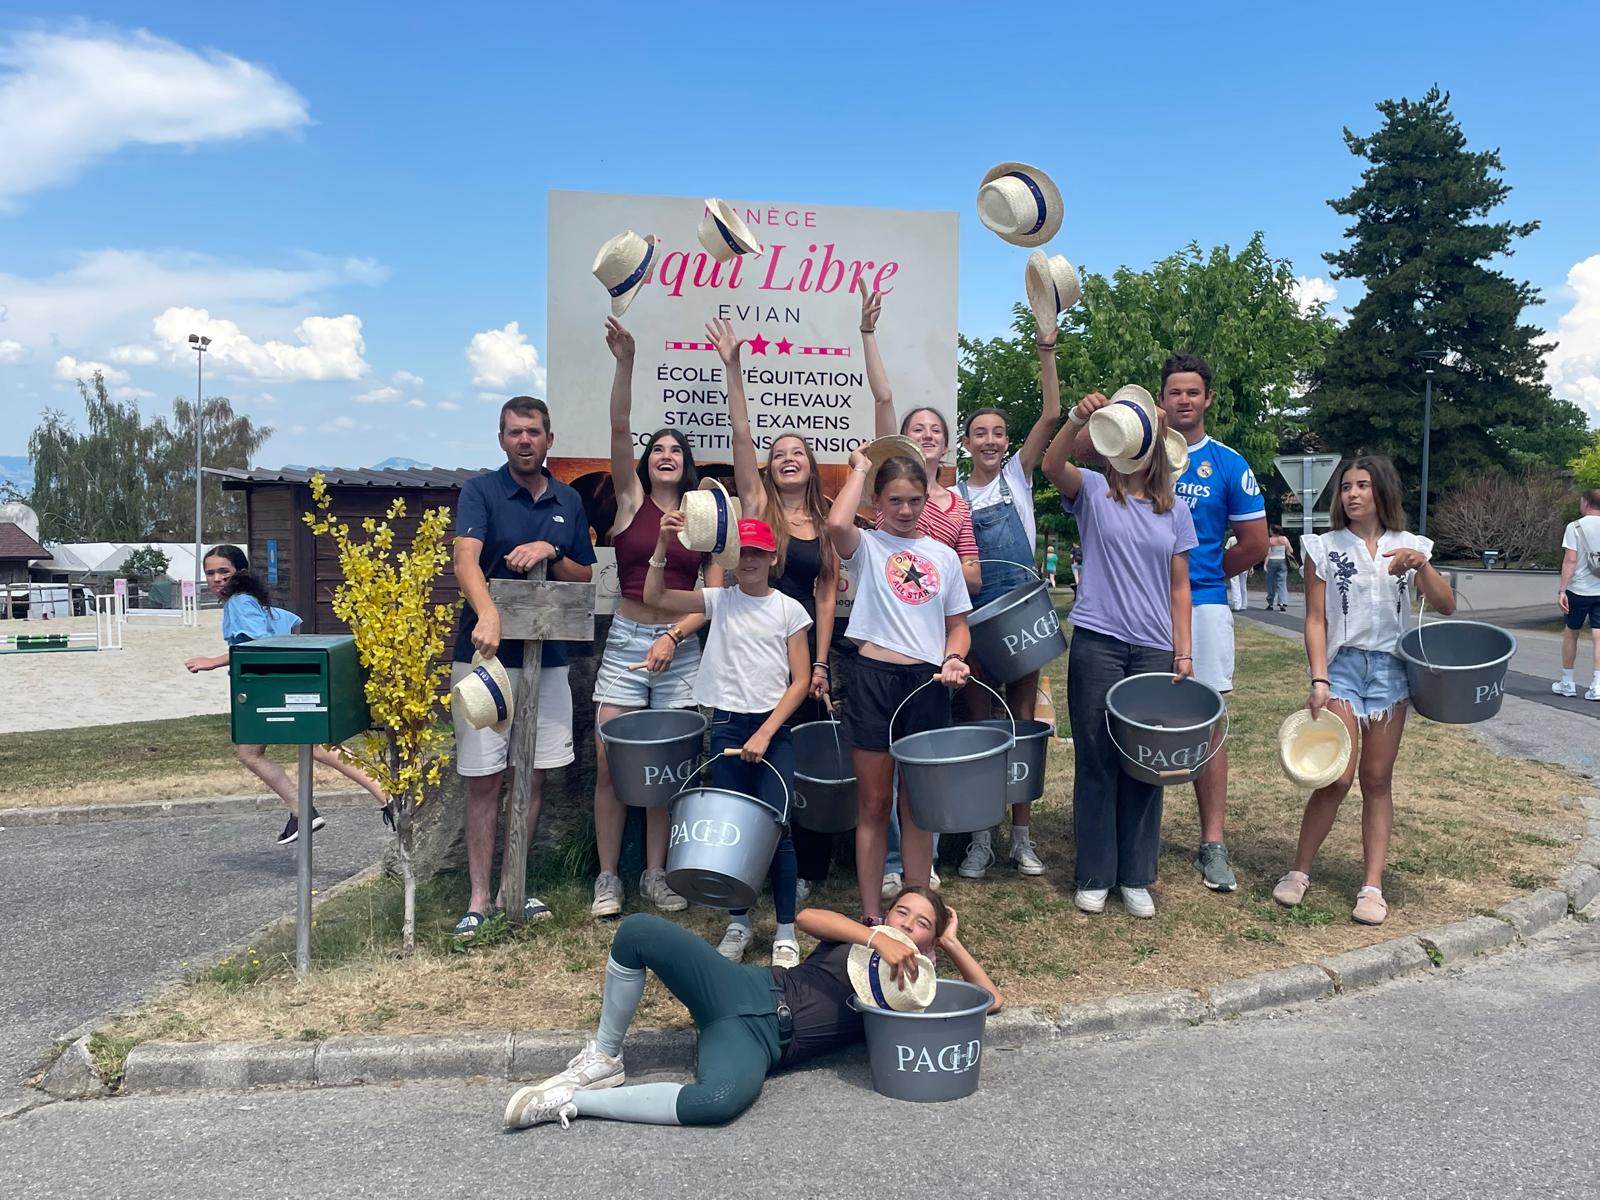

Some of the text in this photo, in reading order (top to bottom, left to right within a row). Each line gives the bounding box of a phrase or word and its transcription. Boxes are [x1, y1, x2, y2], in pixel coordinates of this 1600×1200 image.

[704, 206, 817, 228] NÈGE
[644, 238, 899, 298] qui'Libre
[718, 304, 800, 323] EVIAN
[657, 363, 863, 387] ÉCOLE 'ÉQUITATION
[663, 389, 729, 405] PONEY
[760, 392, 852, 409] CHEVAUX
[757, 414, 850, 430] EXAMENS
